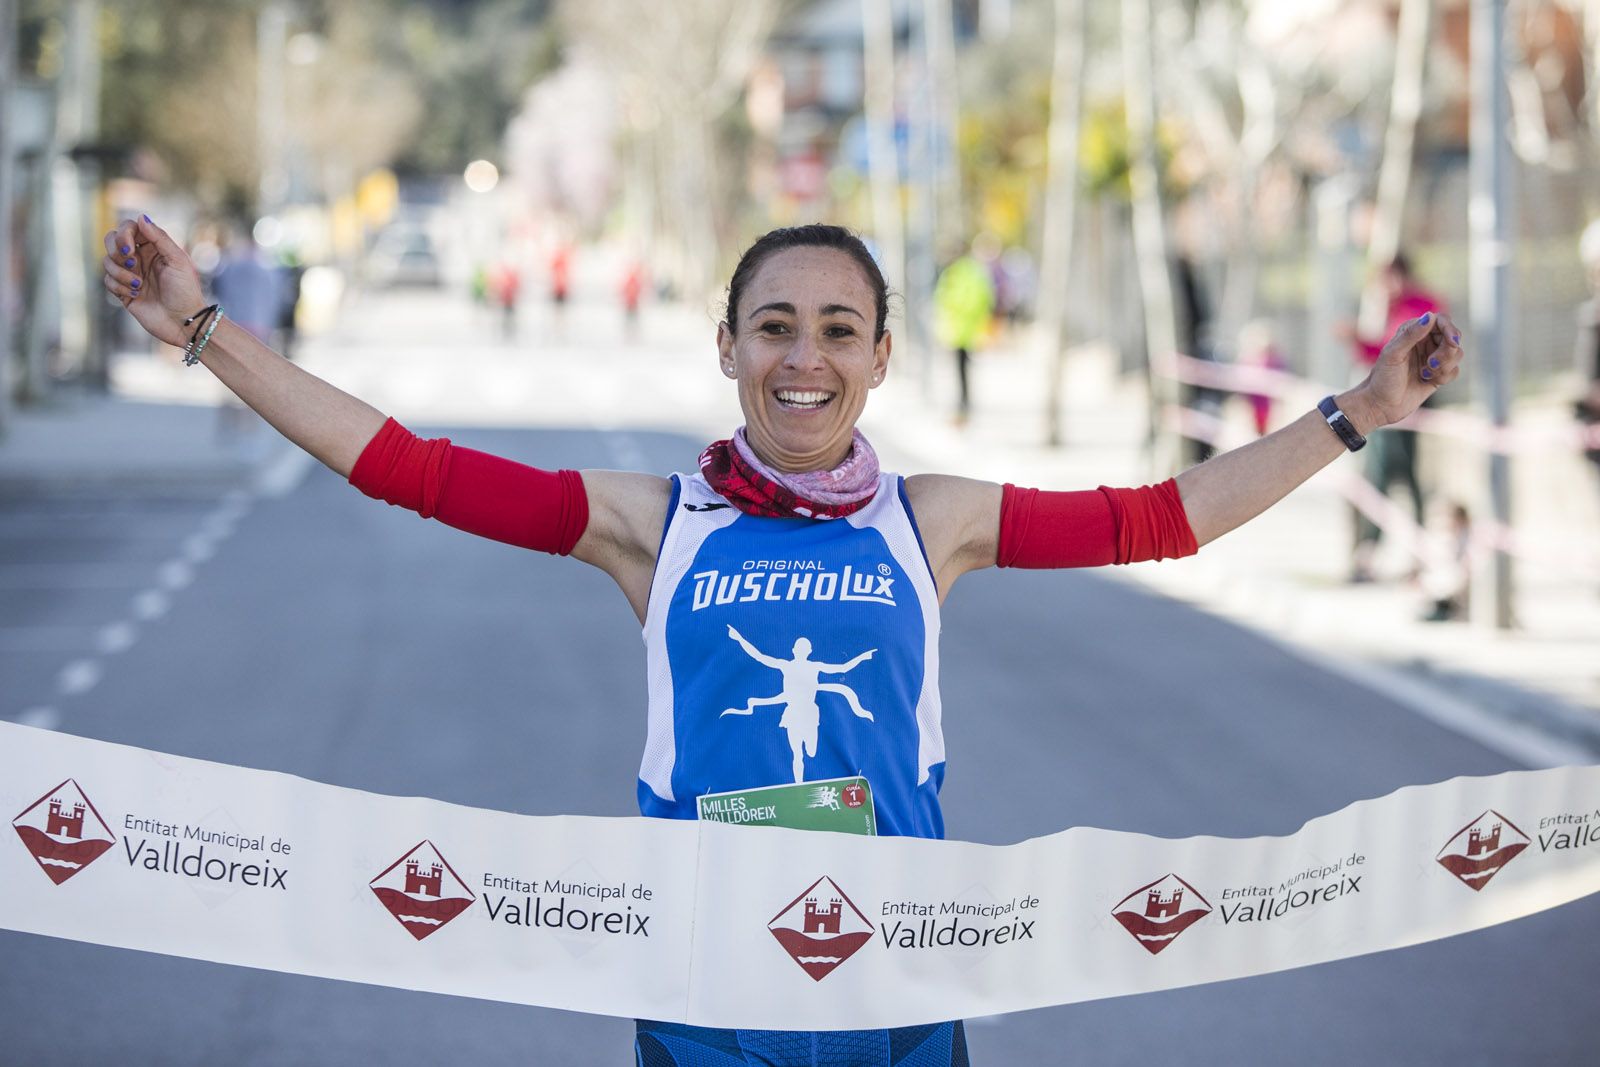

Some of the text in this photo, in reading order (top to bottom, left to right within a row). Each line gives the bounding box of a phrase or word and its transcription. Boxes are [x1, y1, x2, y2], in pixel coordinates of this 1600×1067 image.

[742, 560, 825, 571] ORIGINAL
[703, 797, 746, 815] MILLES
[850, 790, 857, 801] 1
[124, 814, 292, 855] Entitat Municipal de
[1539, 813, 1589, 830] Entitat
[123, 836, 289, 890] Valldoreix
[1222, 853, 1366, 900] Entitat Municipal de
[483, 872, 653, 902] Entitat Municipal de
[1220, 873, 1362, 925] Valldoreix
[483, 893, 650, 937] Valldoreix
[881, 894, 1040, 920] Entitat Municipal de
[881, 916, 1036, 949] Valldoreix
